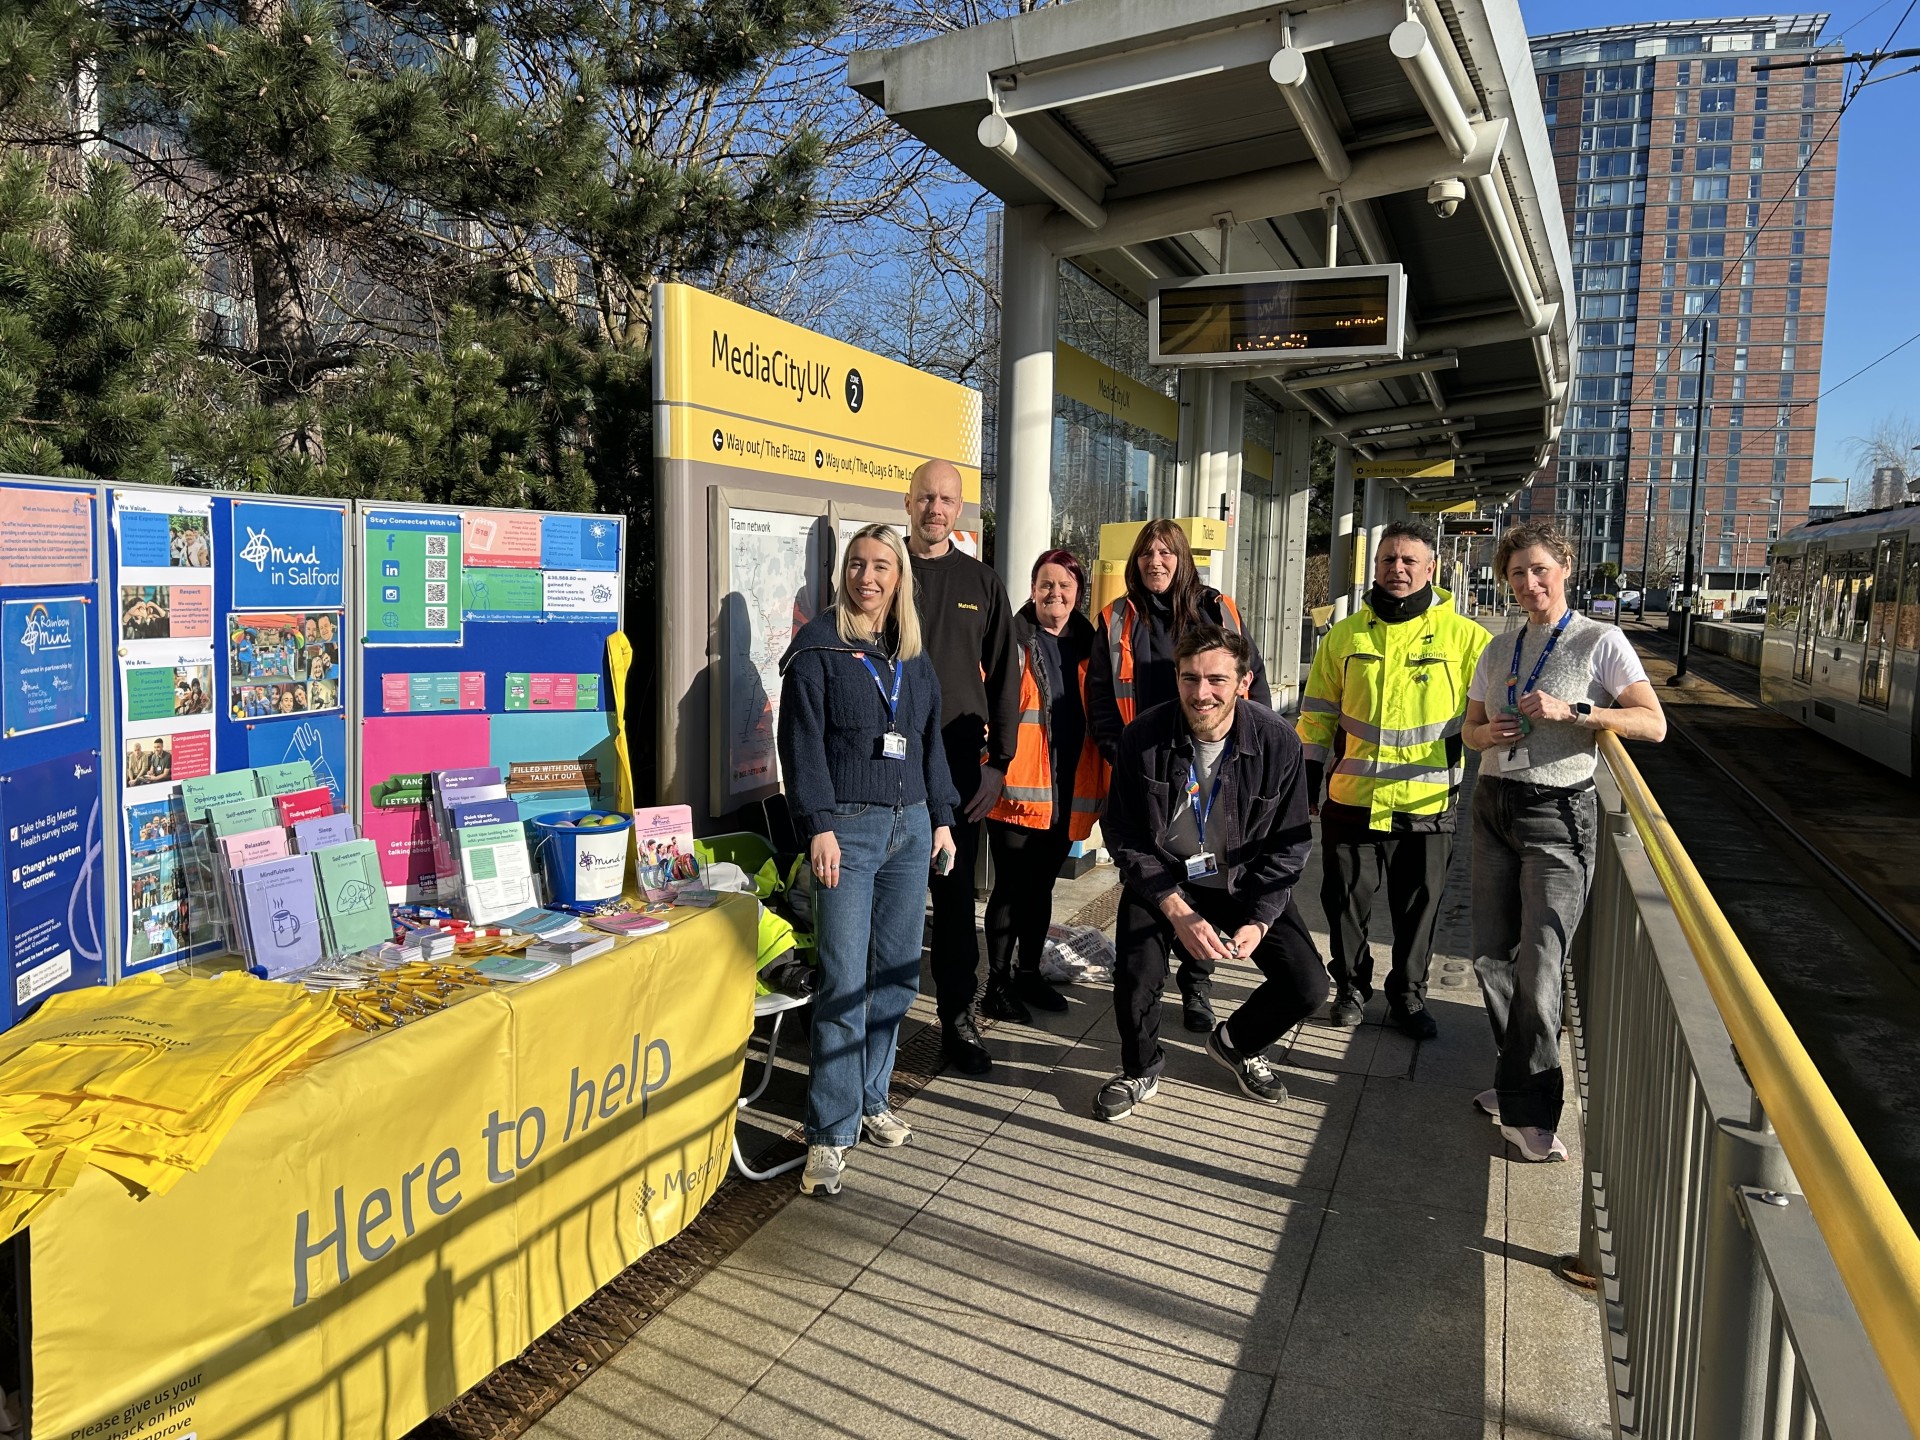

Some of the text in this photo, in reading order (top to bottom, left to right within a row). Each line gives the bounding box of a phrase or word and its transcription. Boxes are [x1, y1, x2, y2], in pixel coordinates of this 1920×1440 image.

[712, 330, 831, 403] MediaCityUK
[849, 374, 860, 384] ZONE
[851, 385, 859, 408] 2
[1098, 378, 1131, 411] MediaCityUK
[726, 432, 744, 457] Way
[782, 444, 806, 463] Piazza
[825, 451, 839, 472] Way
[869, 461, 887, 480] Quays
[888, 465, 893, 478] &
[894, 465, 905, 480] The
[905, 468, 914, 481] Lo
[1380, 466, 1421, 475] Boarding point
[369, 516, 388, 524] Stay
[389, 517, 428, 525] Connected
[429, 518, 446, 526] With
[731, 518, 771, 533] Tram network
[475, 527, 489, 537] 518
[839, 529, 852, 540] Using
[271, 566, 340, 586] in Salford
[40, 615, 70, 628] Rainbow
[1410, 652, 1448, 660] Metrolink
[20, 666, 39, 675] delivered
[44, 663, 67, 673] partnership
[172, 733, 210, 742] Compassionate
[513, 763, 593, 773] FILLED WITH DOUBT?
[401, 778, 429, 786] FANCY
[530, 773, 550, 781] TALK
[561, 772, 576, 780] OUT
[275, 782, 295, 790] Looking
[194, 790, 243, 805] Opening up about
[385, 797, 408, 805] LET'S
[194, 803, 207, 813] your
[225, 808, 257, 819] Self-esteem
[289, 806, 322, 819] Finding support
[20, 805, 77, 835] Take the Big Mental
[464, 816, 500, 826] physical activity
[20, 820, 79, 849] Health survey today.
[318, 826, 333, 835] Sleep
[244, 839, 271, 850] Relaxation
[331, 852, 361, 862] Self-esteem
[388, 848, 411, 856] talking
[21, 845, 81, 876] Change the system
[259, 866, 295, 879] Mindfulness
[22, 869, 56, 889] tomorrow.
[1084, 932, 1094, 940] on
[92, 1015, 156, 1026] Metrolink
[155, 1036, 191, 1047] with
[292, 1033, 673, 1308] Here to help
[70, 1373, 202, 1440] Please give us your
[148, 1412, 165, 1427] on
[169, 1395, 197, 1417] how
